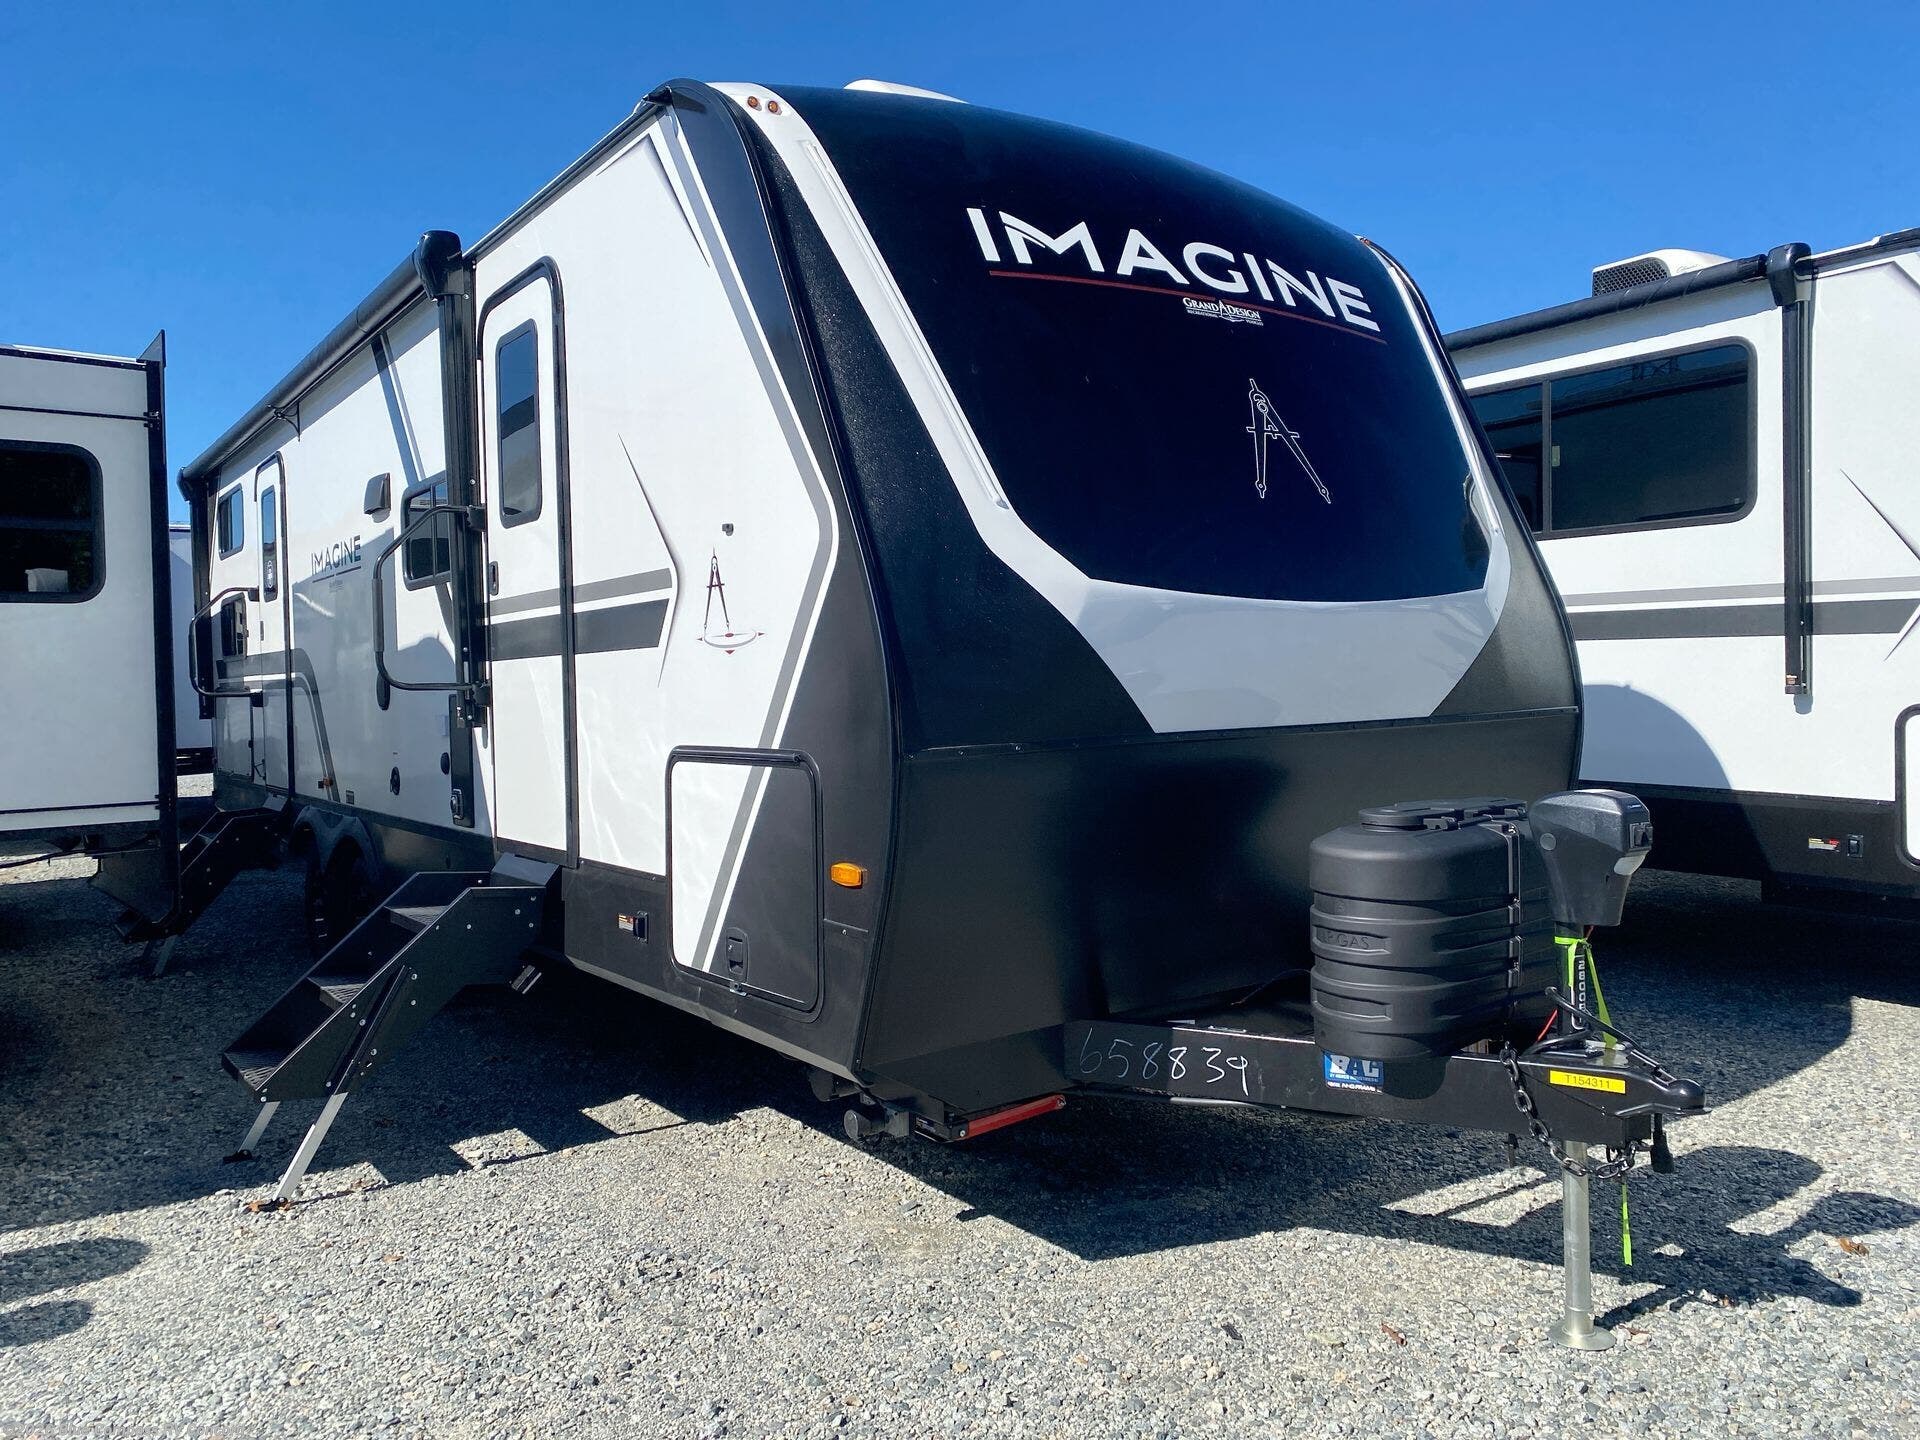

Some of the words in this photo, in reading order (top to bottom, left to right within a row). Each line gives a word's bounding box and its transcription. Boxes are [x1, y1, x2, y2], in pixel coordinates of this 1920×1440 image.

[966, 207, 1381, 332] IMAGINE
[1182, 297, 1219, 312] GRAND
[1225, 304, 1261, 319] DESIGN
[311, 534, 361, 577] IMAGINE
[1337, 933, 1370, 950] GAS
[1080, 1027, 1249, 1097] 658839
[1565, 1074, 1610, 1089] T154311
